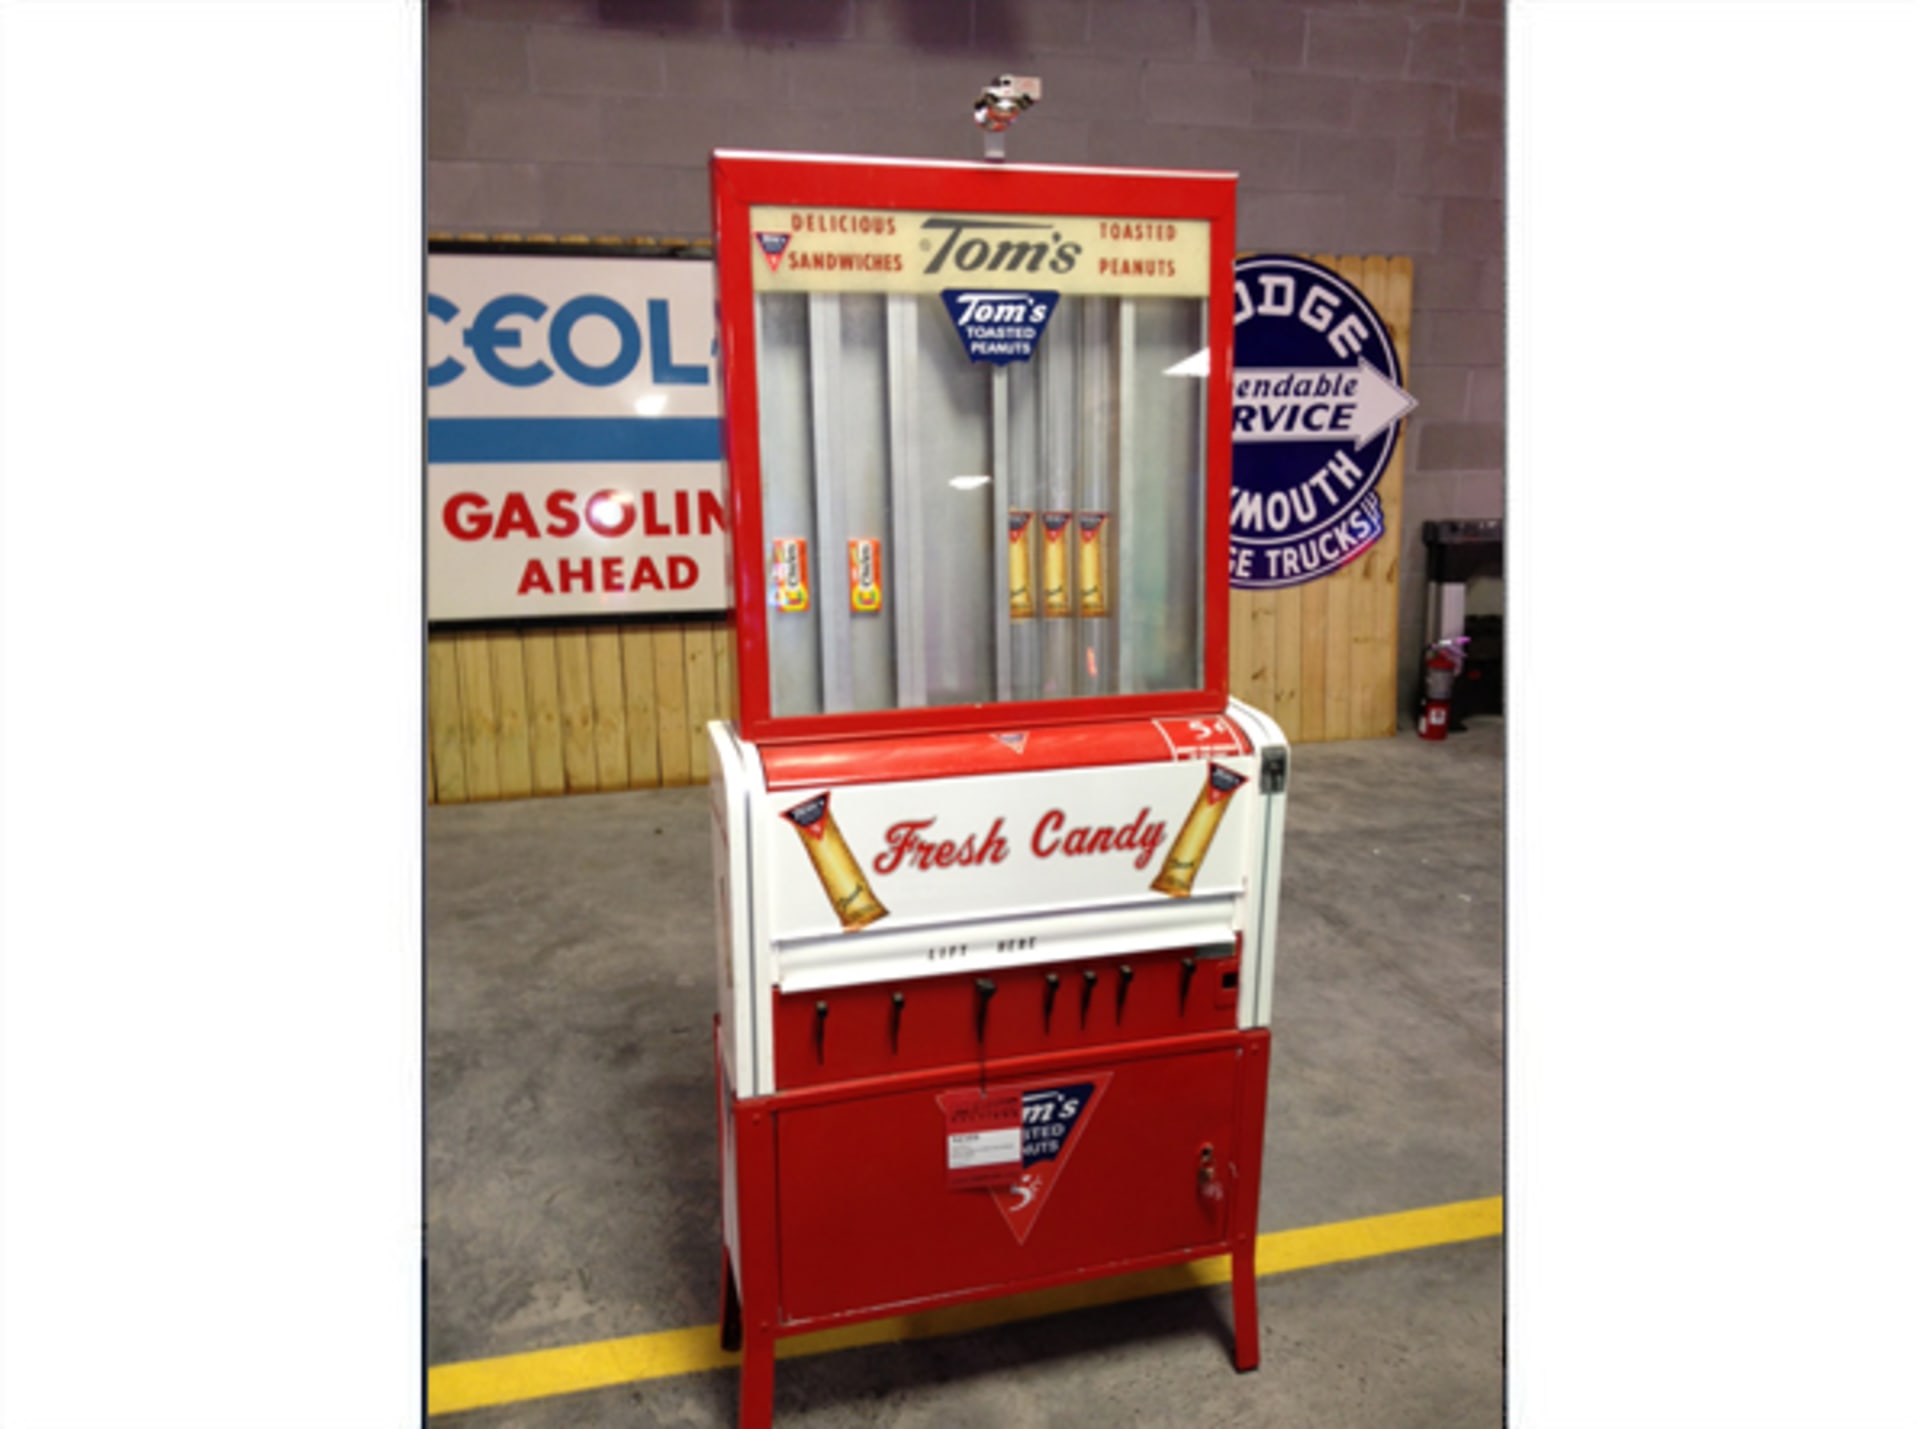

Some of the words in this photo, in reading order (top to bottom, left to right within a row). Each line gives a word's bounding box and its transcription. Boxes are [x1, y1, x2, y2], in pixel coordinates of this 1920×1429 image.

[791, 212, 897, 236] DELICIOUS
[1099, 221, 1177, 242] TOASTED
[921, 217, 1083, 275] Tom's
[788, 251, 904, 272] SANDWICHES
[1098, 256, 1176, 278] PEANUTS
[956, 292, 1048, 326] Tom's
[428, 293, 717, 388] CEOL
[966, 325, 1037, 340] TOASTED
[970, 341, 1031, 355] PEANUTS
[1264, 510, 1373, 578] TRUCKS
[517, 555, 700, 595] AHEAD
[872, 815, 1010, 875] Fresh
[1030, 807, 1167, 870] Candy
